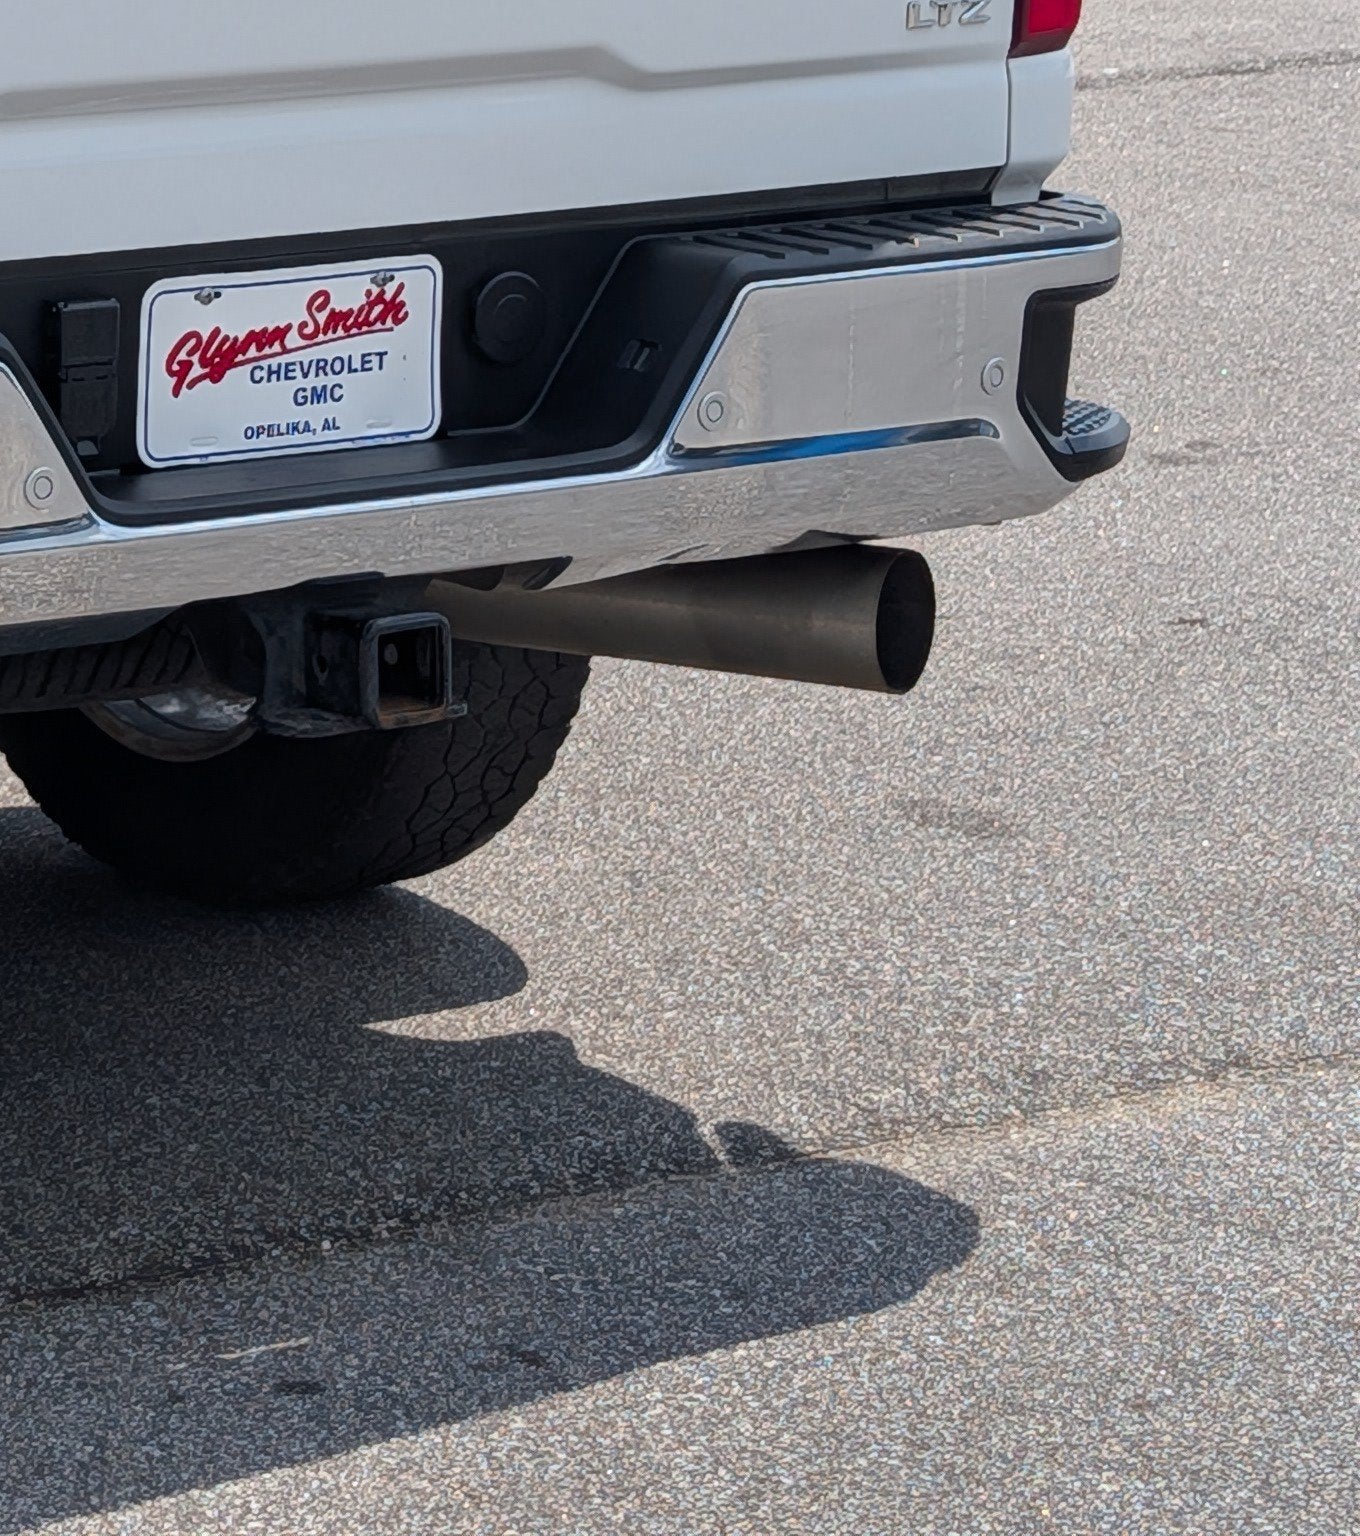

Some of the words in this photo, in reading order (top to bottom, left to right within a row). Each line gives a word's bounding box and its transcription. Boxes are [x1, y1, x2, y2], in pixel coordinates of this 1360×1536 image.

[165, 325, 293, 398] Glynn
[296, 281, 409, 341] Smith
[249, 350, 389, 384] CHEVROLET
[292, 382, 344, 407] GMC
[243, 417, 317, 440] OPELIKA,
[320, 416, 341, 432] AL
